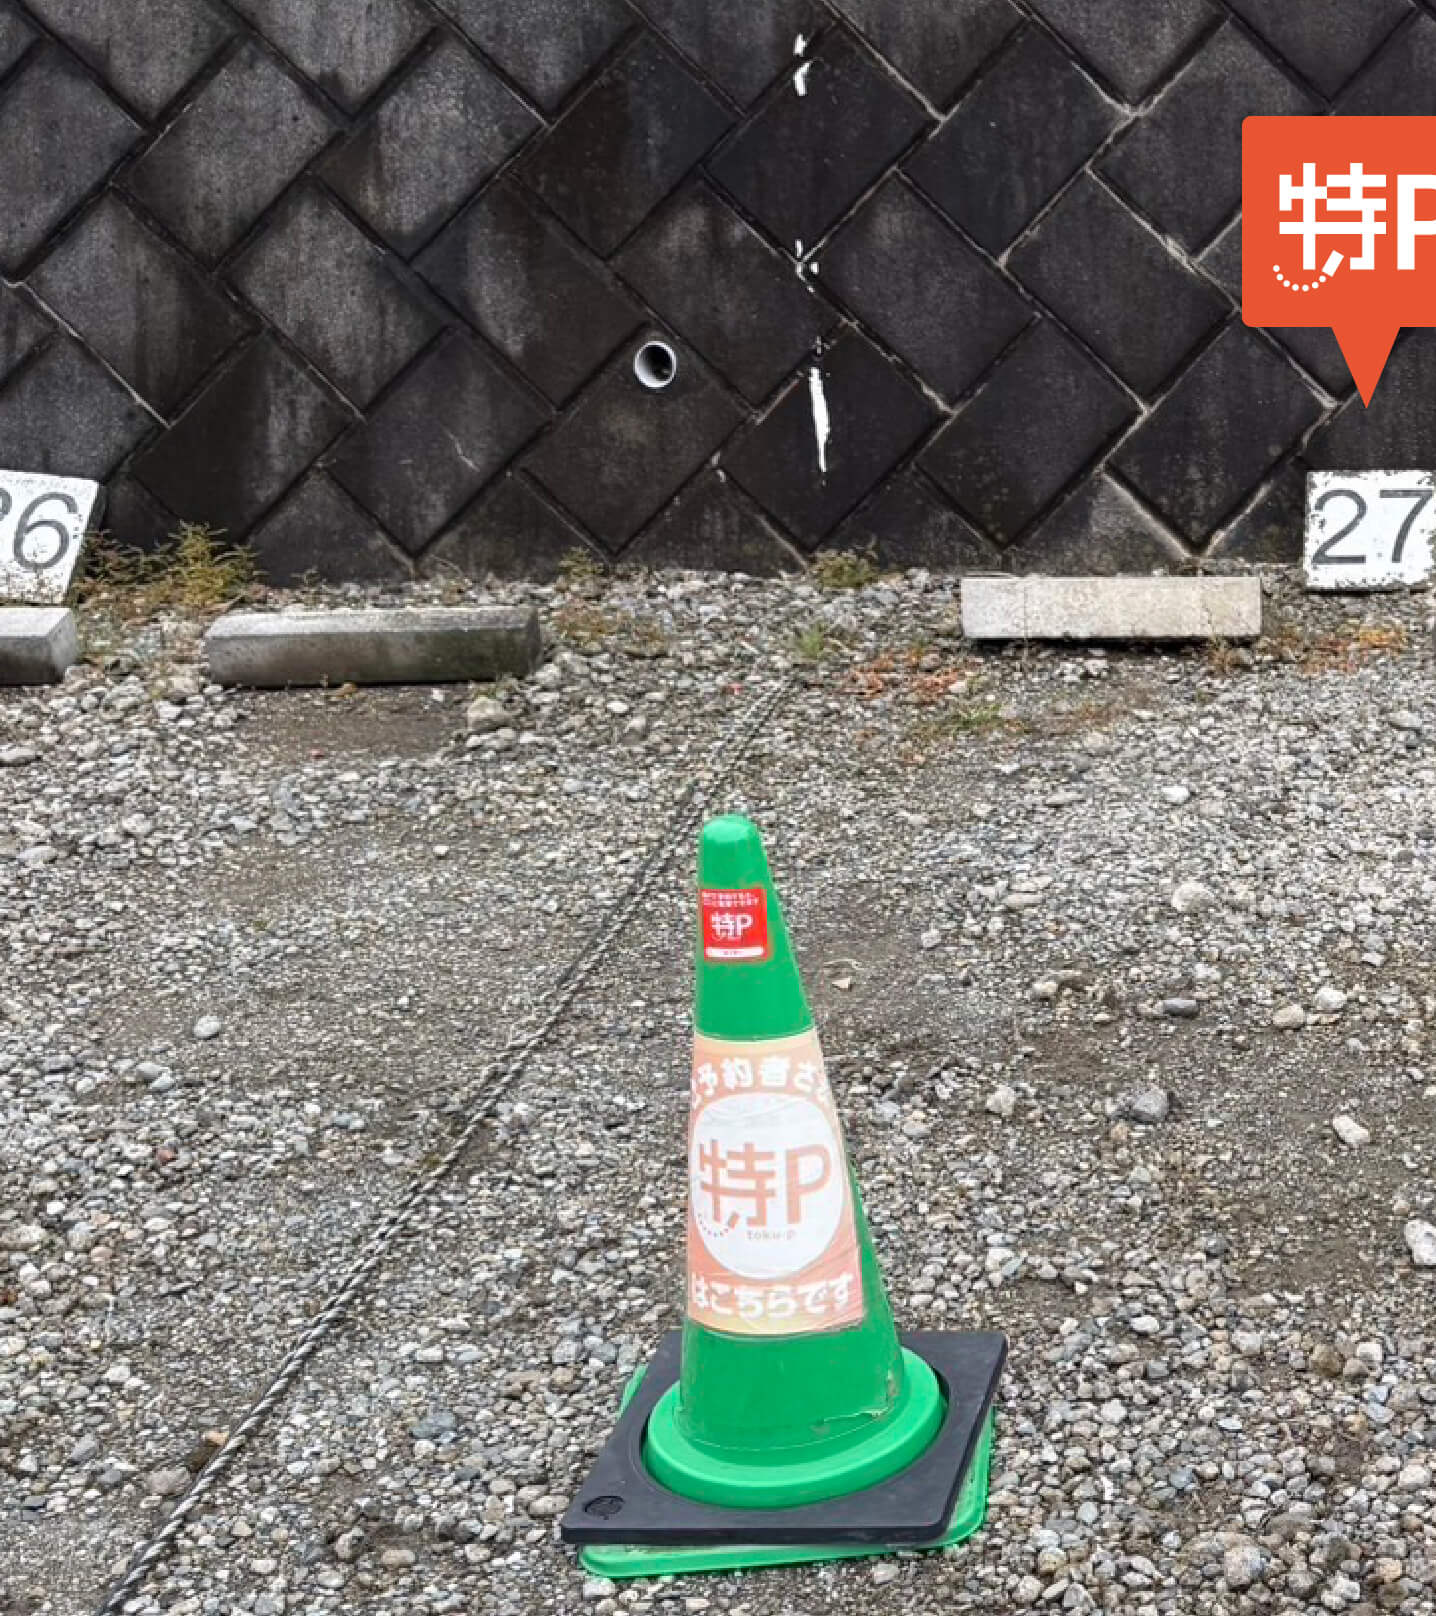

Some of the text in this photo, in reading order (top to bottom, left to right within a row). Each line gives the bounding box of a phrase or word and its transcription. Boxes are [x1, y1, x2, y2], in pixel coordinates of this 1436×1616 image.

[0, 487, 79, 570] 6
[1311, 489, 1433, 565] 27
[698, 1138, 831, 1229] 特P
[691, 1272, 854, 1319] はこちらです
